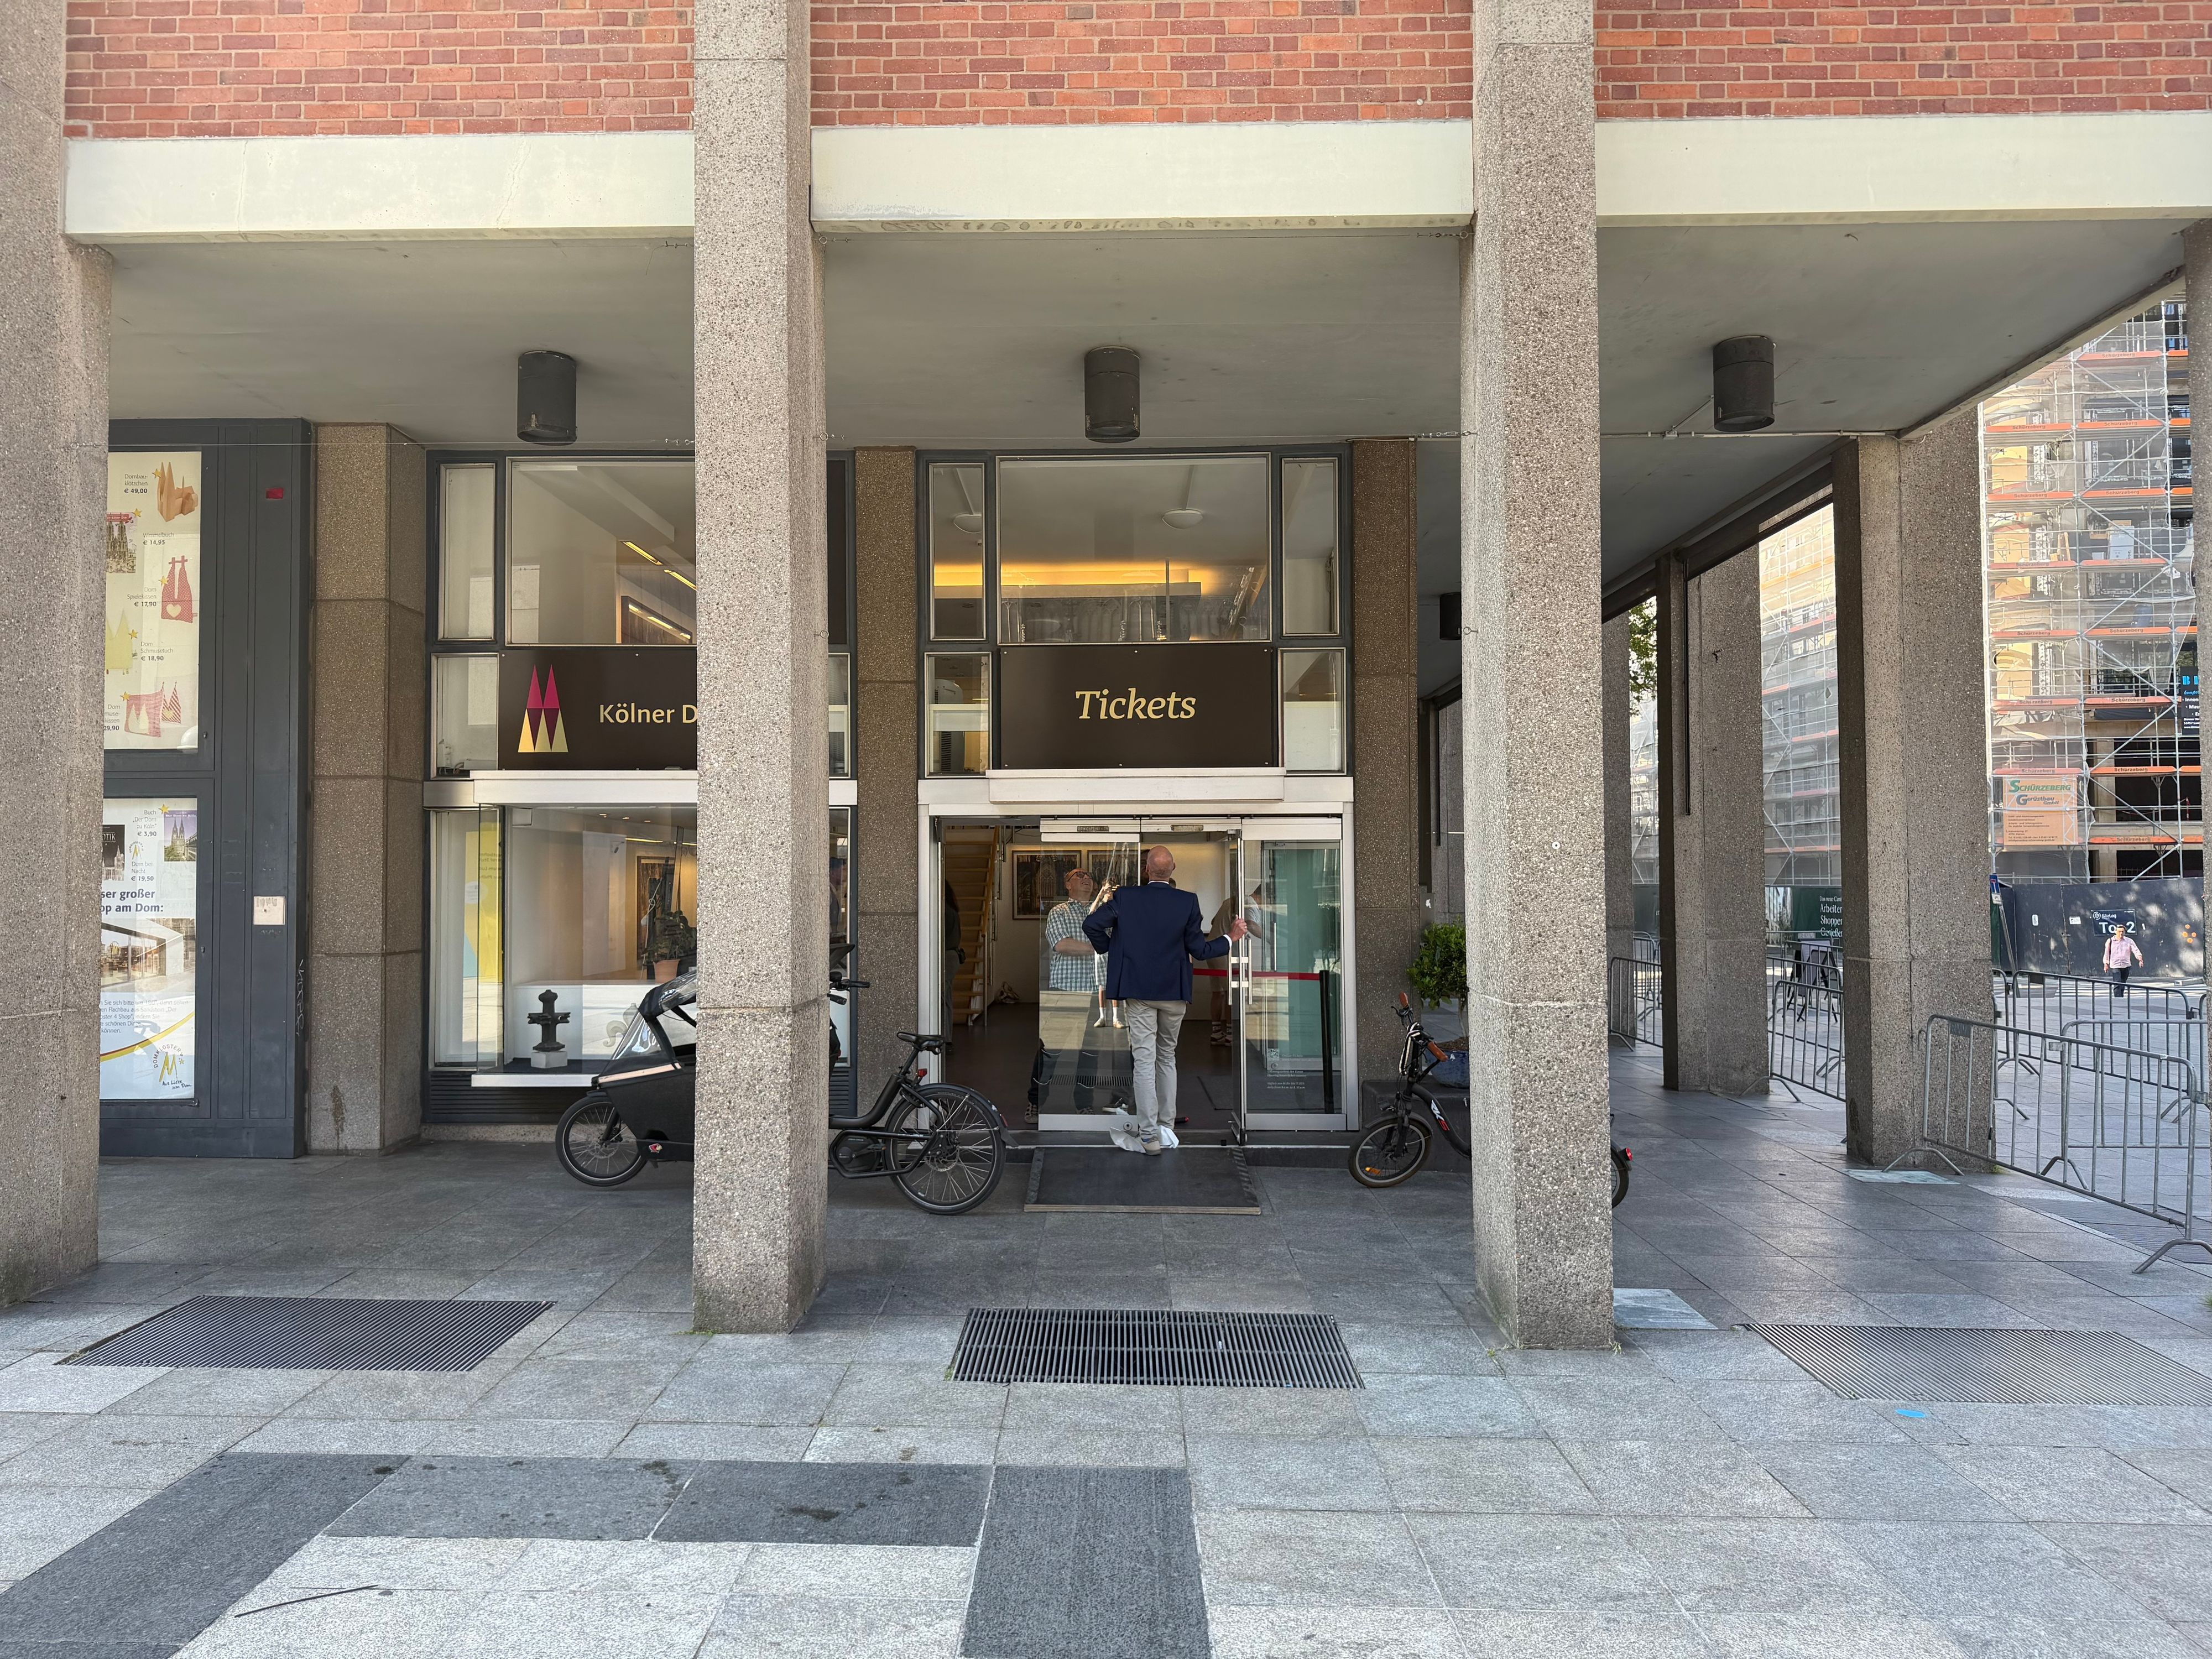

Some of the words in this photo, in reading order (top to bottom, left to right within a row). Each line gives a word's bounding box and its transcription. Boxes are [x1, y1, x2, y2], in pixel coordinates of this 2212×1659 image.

[1075, 687, 1196, 719] Tickets
[599, 702, 675, 723] Kölner
[2016, 794, 2054, 806] Gerüstbau
[119, 888, 155, 901] großer
[135, 903, 164, 912] Dom:
[2099, 922, 2116, 933] To
[2126, 921, 2136, 933] 2
[153, 1044, 181, 1068] DOMKLOSTER
